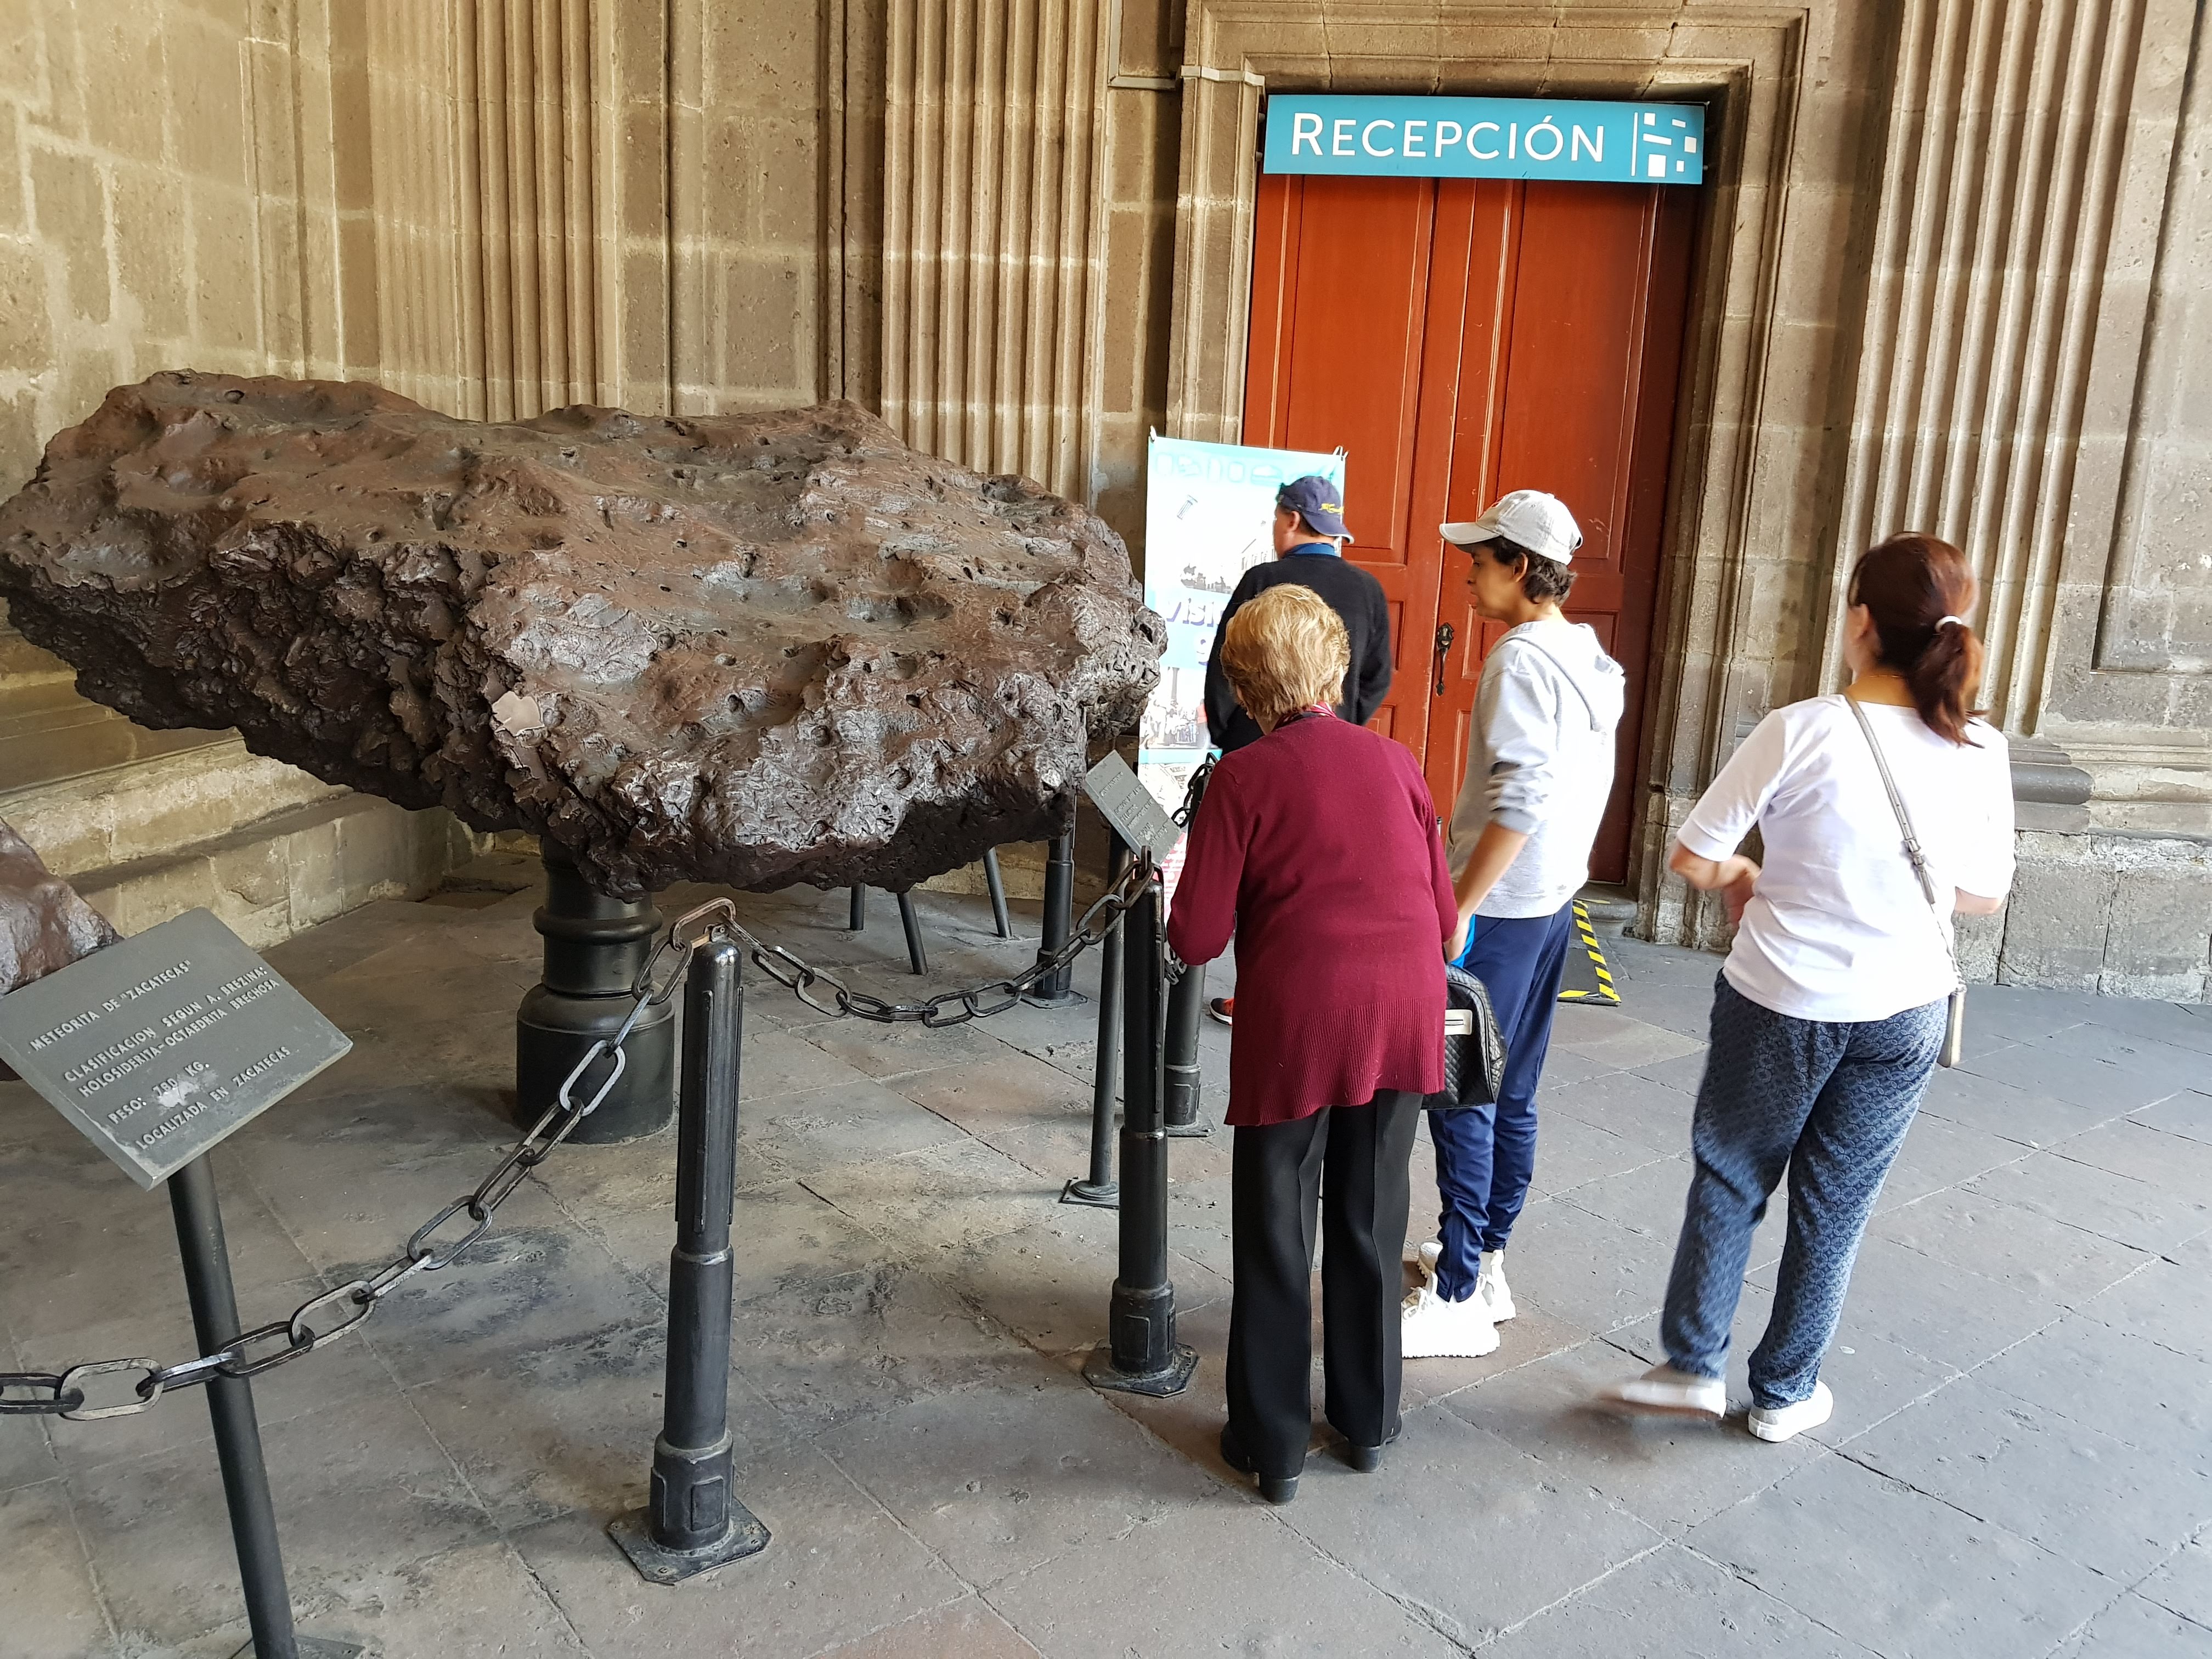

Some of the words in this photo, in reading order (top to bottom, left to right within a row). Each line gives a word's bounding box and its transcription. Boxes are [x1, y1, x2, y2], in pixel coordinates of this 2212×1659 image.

[1291, 112, 1605, 163] RECEPCIÓN
[64, 1026, 156, 1082] CLASIFICACION
[162, 1001, 202, 1028] SEGUN
[206, 994, 221, 1005] A.
[220, 966, 268, 997] BREZINA:
[229, 979, 280, 1010] BRECHOSA
[30, 1010, 100, 1052] METEORITA
[102, 998, 121, 1013] DE
[108, 1097, 147, 1125] PESO:
[184, 1061, 210, 1077] KG.
[136, 1101, 208, 1150] LOCALIZADA
[210, 1086, 229, 1102] EN
[232, 1046, 291, 1088] ZACATECAS
